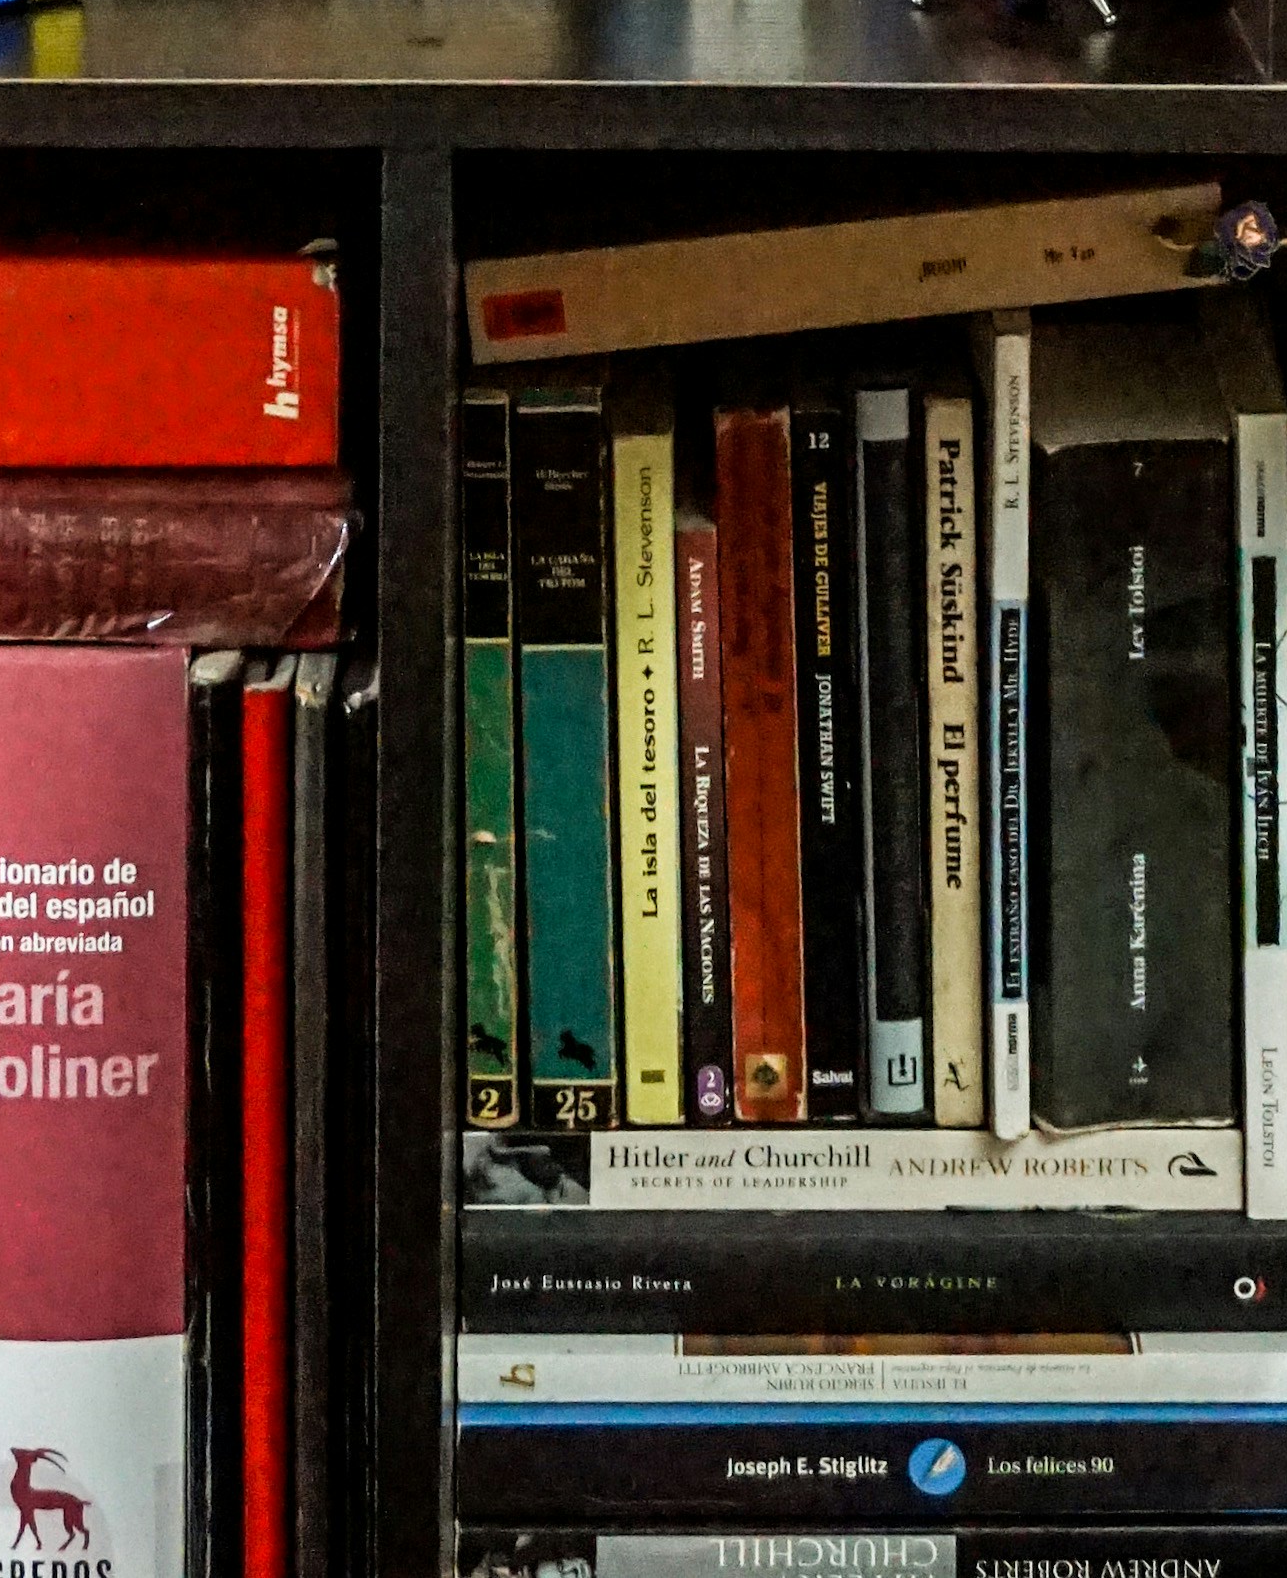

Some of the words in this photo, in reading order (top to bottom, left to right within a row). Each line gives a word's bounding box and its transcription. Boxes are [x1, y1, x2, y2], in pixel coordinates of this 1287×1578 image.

[938, 438, 963, 550] Patrick
[940, 563, 964, 683] Süskind
[943, 723, 966, 750] El
[937, 758, 968, 890] perfume
[99, 853, 141, 884] de
[46, 890, 154, 925] español
[19, 931, 129, 954] abreviada
[1130, 956, 1146, 1008] Anna
[556, 1089, 597, 1124] 25
[608, 1145, 684, 1169] Hitler
[694, 1149, 736, 1168] and
[743, 1144, 871, 1168] Churchill
[894, 1150, 1013, 1177] ANDREW
[1024, 1157, 1148, 1177] ROBERTS
[631, 1176, 703, 1189] SECRETS
[712, 1176, 732, 1189] OF
[742, 1176, 848, 1189] LEADERSHIP
[726, 1457, 791, 1480] Joseph
[797, 1457, 814, 1475] E.
[819, 1455, 888, 1479] Stiglitz
